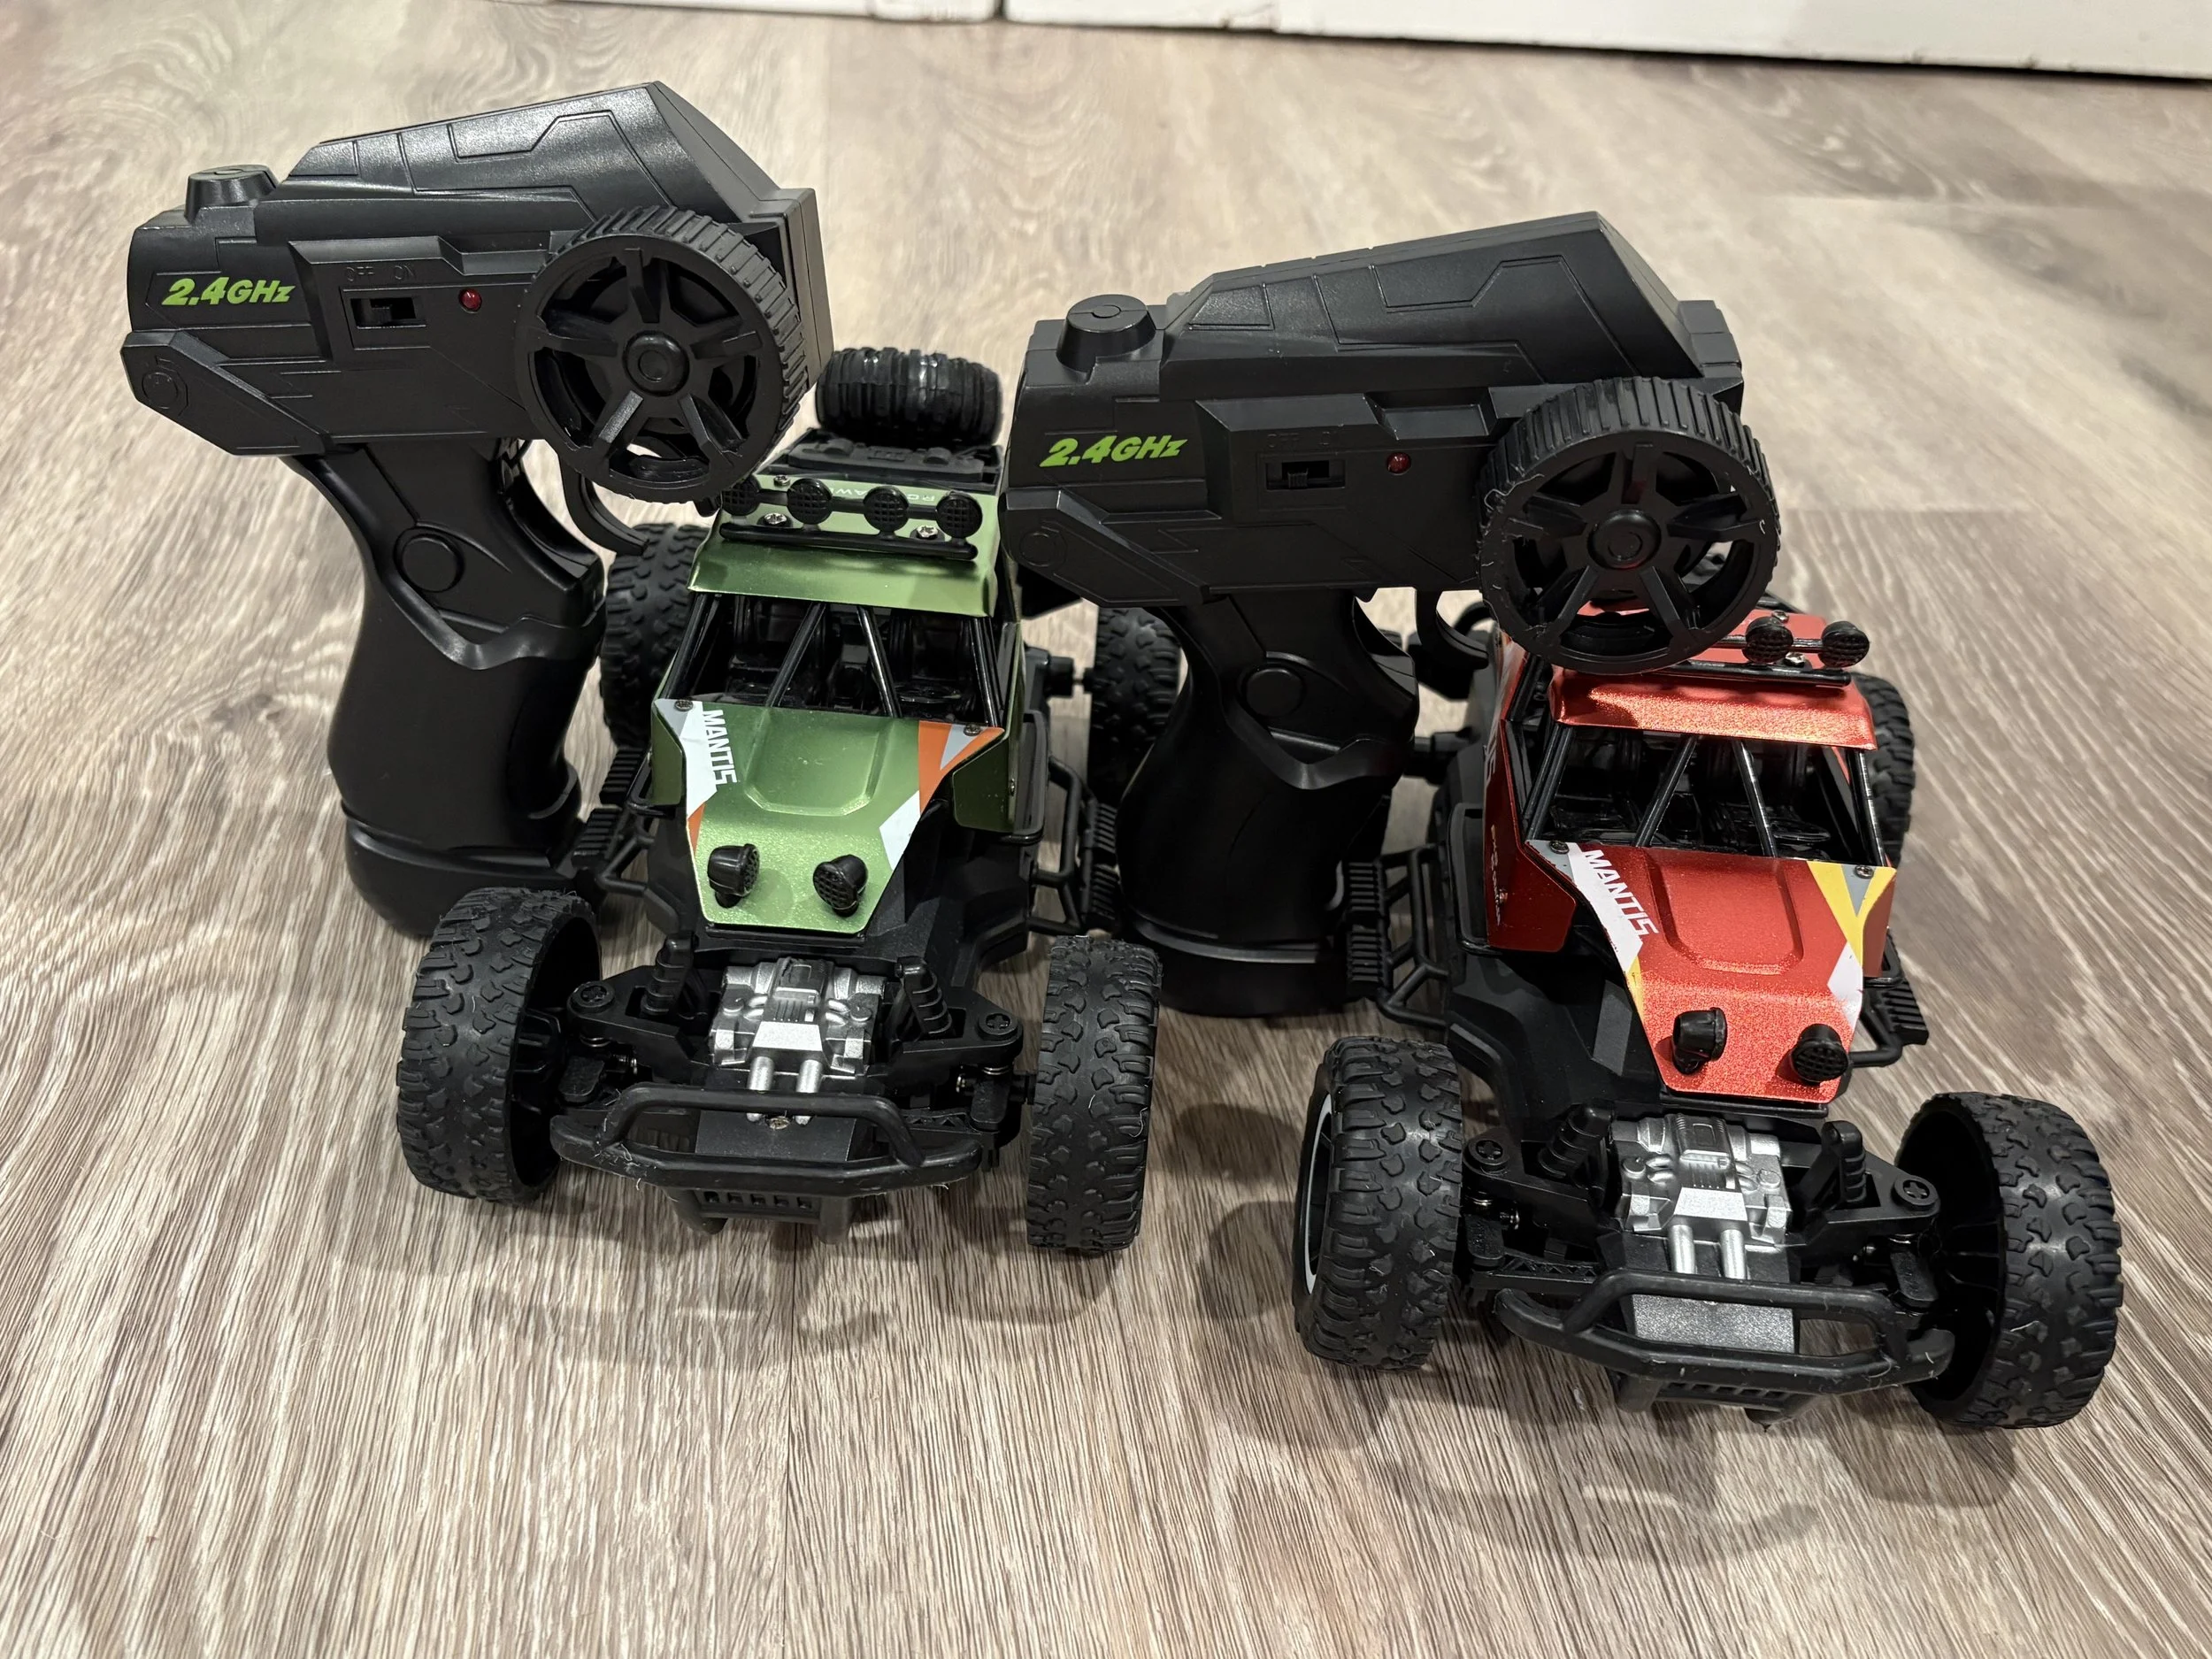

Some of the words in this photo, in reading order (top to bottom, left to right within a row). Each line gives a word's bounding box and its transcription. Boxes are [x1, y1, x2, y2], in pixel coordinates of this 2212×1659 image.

[161, 276, 296, 306] 2.4GHz
[1039, 434, 1188, 467] 2.4GHz
[703, 709, 738, 787] MANTIS
[1581, 849, 1660, 936] MANTIS
